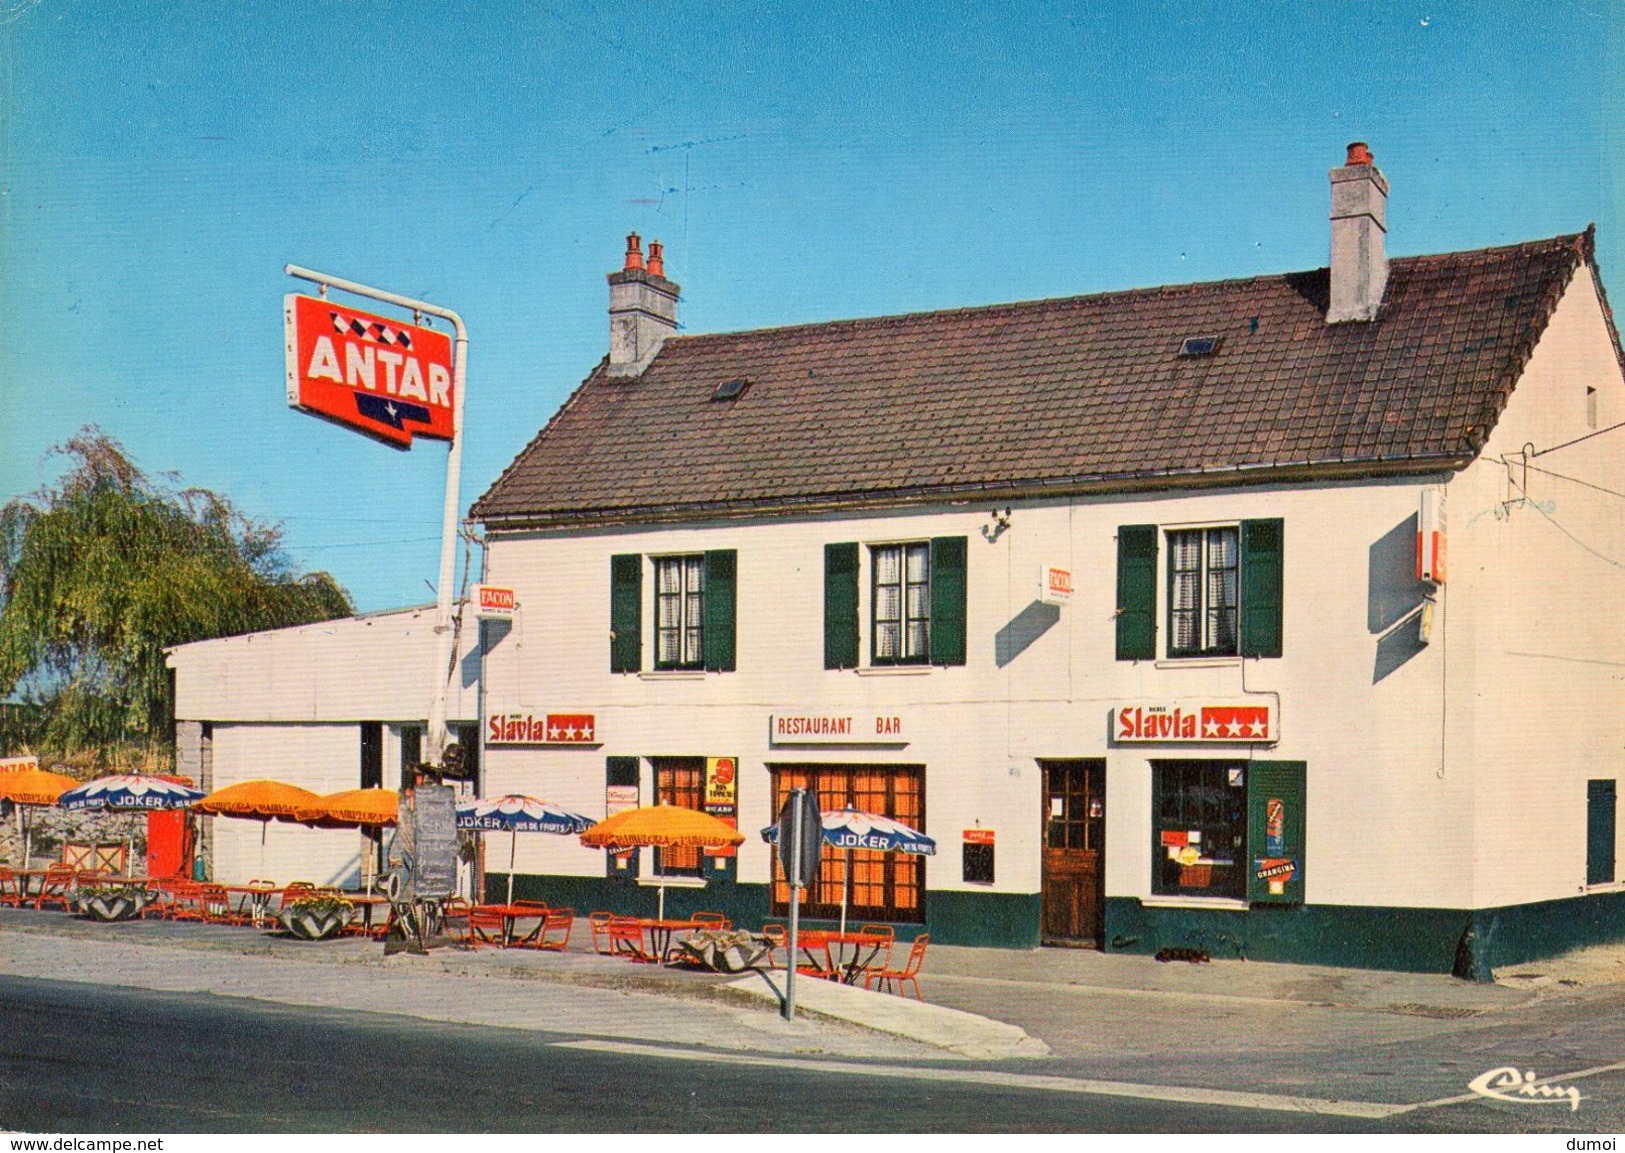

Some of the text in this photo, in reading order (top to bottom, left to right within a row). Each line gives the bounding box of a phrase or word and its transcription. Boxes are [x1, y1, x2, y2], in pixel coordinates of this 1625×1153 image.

[308, 336, 451, 407] ANTAR
[489, 715, 544, 741] Slavia
[778, 717, 901, 734] RESTAURANT BAR
[1119, 707, 1196, 738] Slavia
[116, 795, 163, 807] JOKER
[457, 816, 500, 828] JOKER
[540, 822, 566, 833] FRUITS
[835, 833, 890, 848] JOKER
[1257, 862, 1296, 879] ORANGINA
